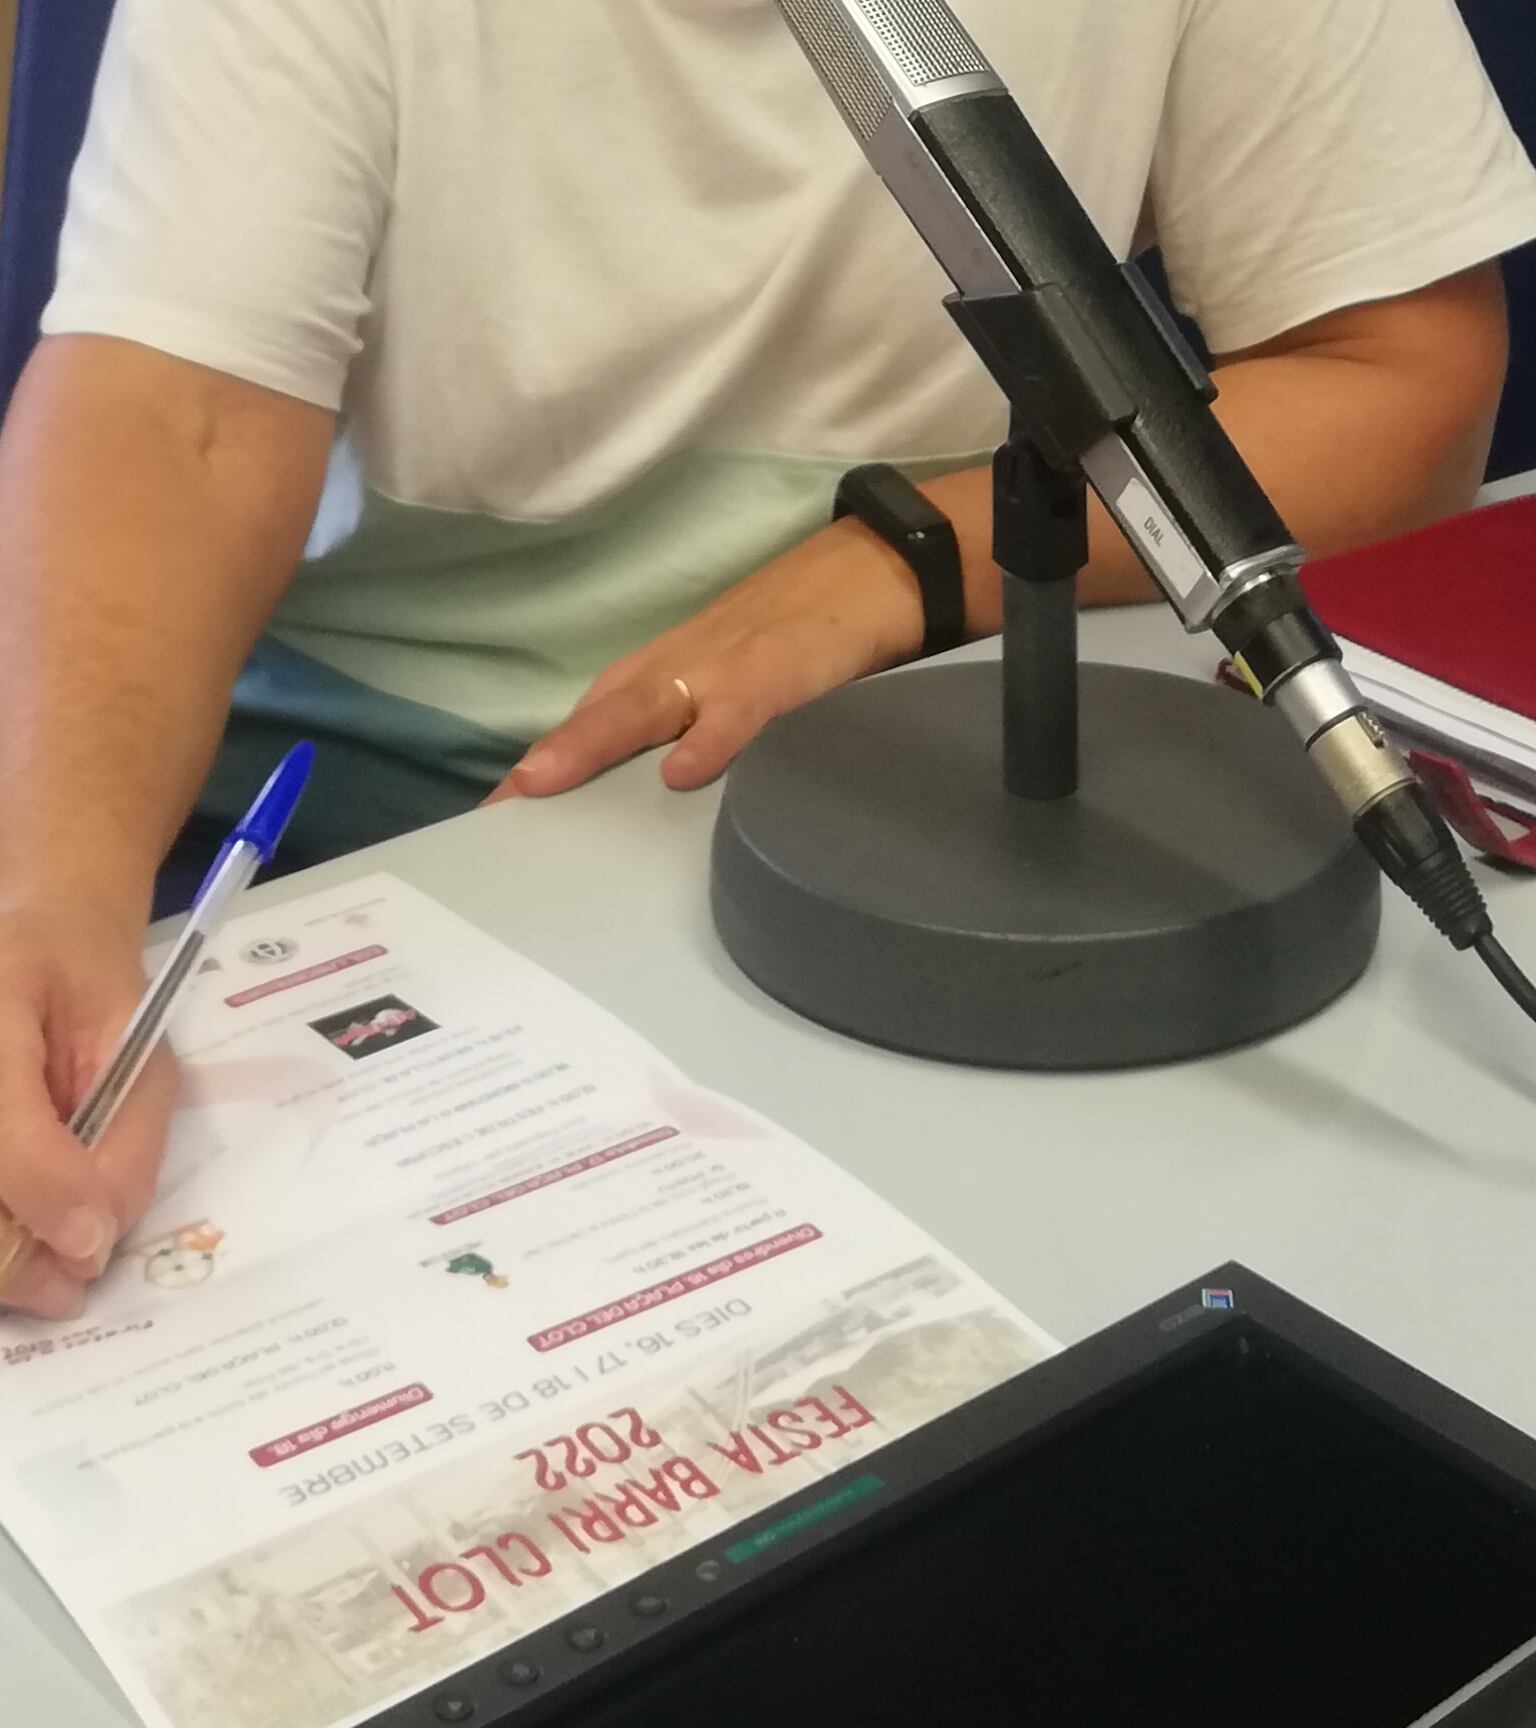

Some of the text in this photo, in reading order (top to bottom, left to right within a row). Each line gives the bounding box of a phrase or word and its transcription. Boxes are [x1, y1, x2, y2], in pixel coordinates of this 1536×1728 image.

[1143, 516, 1164, 547] DIAL
[675, 1299, 752, 1337] DIES
[625, 1333, 674, 1354] 16,
[598, 1352, 627, 1375] 17
[533, 1375, 571, 1398] 18
[327, 1388, 424, 1430] Diumenge
[482, 1392, 529, 1421] DE
[713, 1386, 875, 1476] FESTA
[515, 1407, 662, 1494] 2022
[551, 1458, 719, 1551] BARRI
[393, 1532, 551, 1632] CLOT
